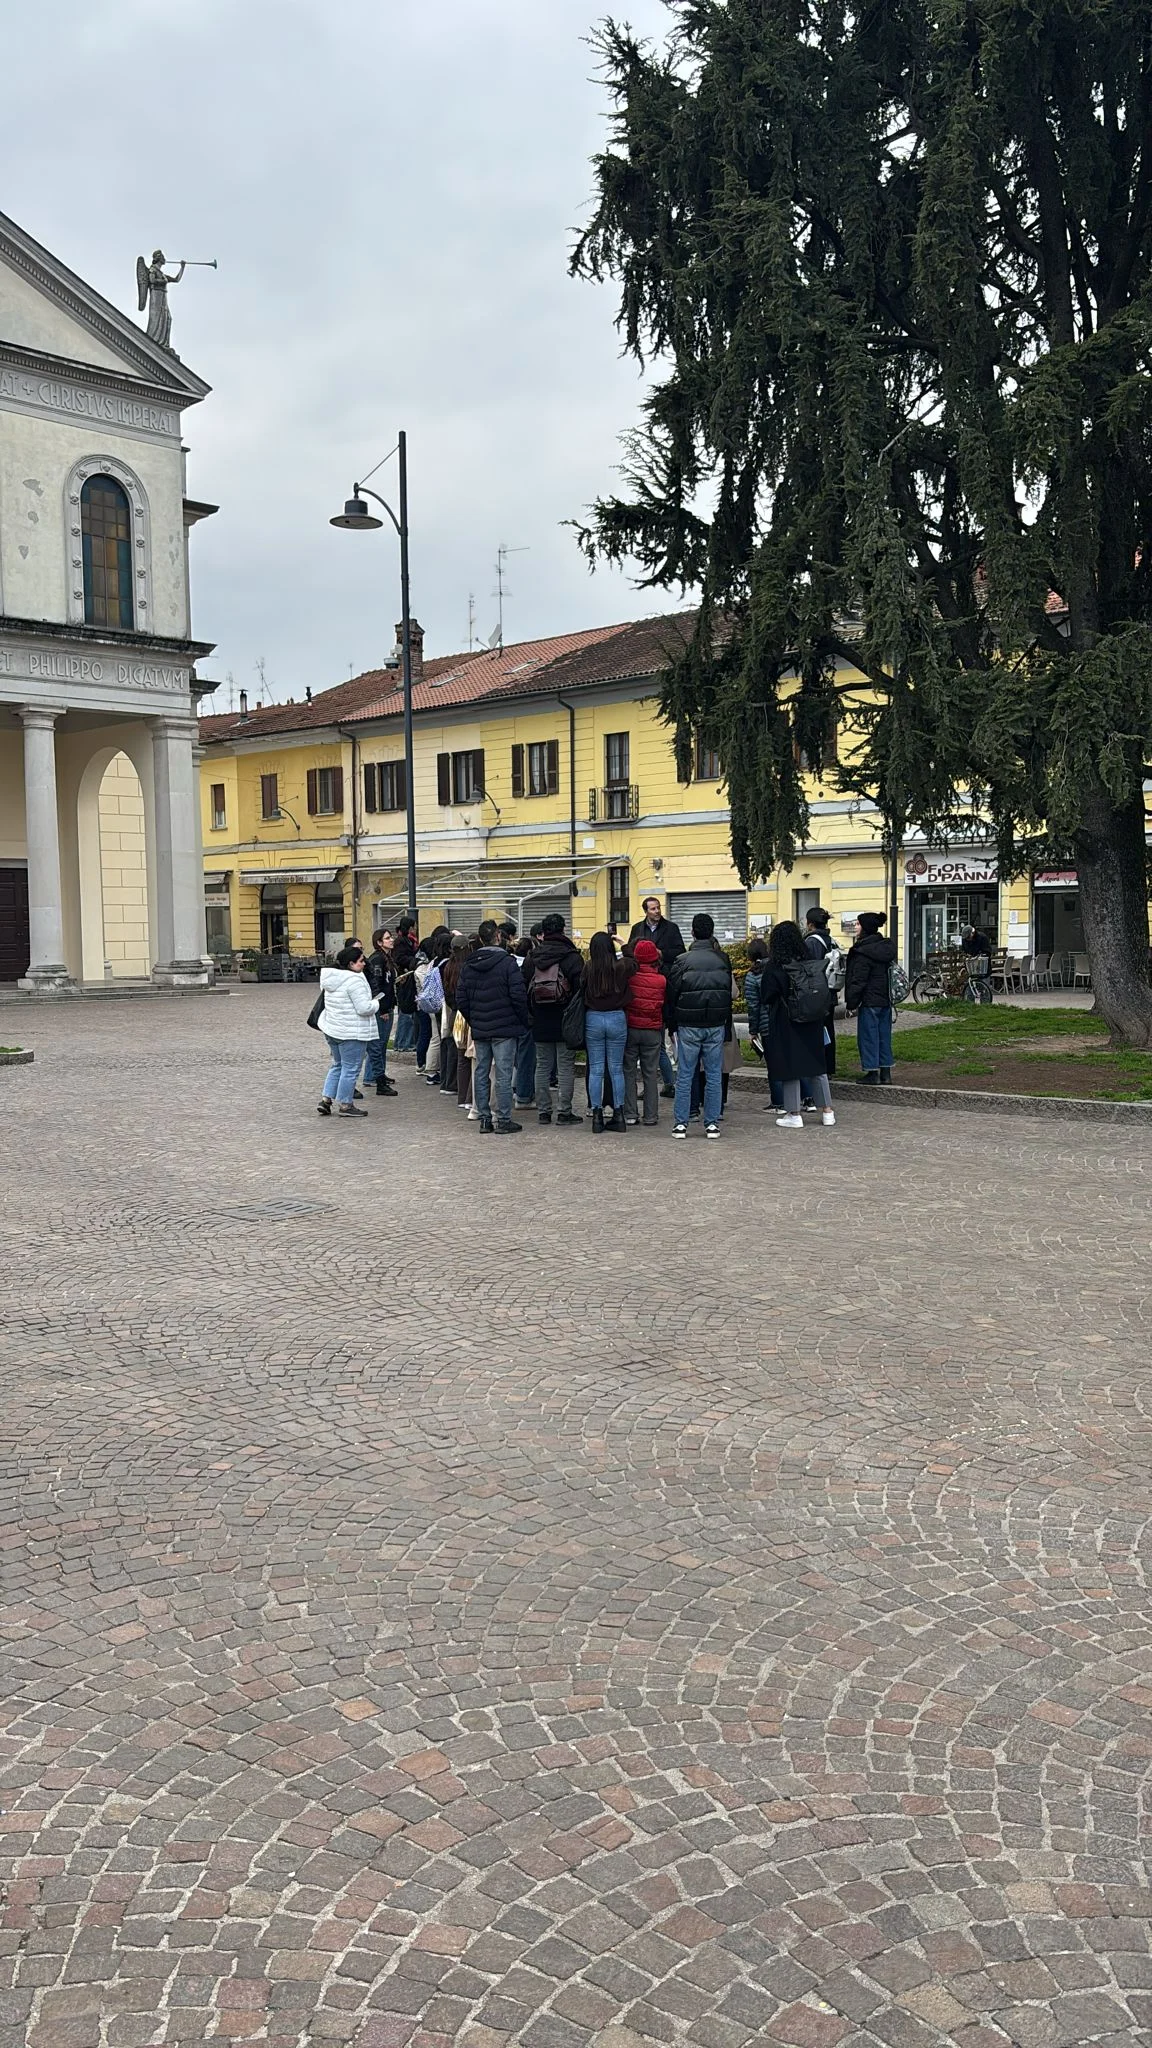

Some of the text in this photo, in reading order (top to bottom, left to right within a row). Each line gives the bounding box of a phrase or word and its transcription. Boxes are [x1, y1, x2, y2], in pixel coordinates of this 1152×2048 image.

[38, 383, 114, 420] CHRISTVS
[117, 401, 175, 434] IMPERAT
[29, 652, 104, 681] PHILIPPO
[117, 664, 186, 689] DICATVM
[928, 863, 967, 876] FIOR
